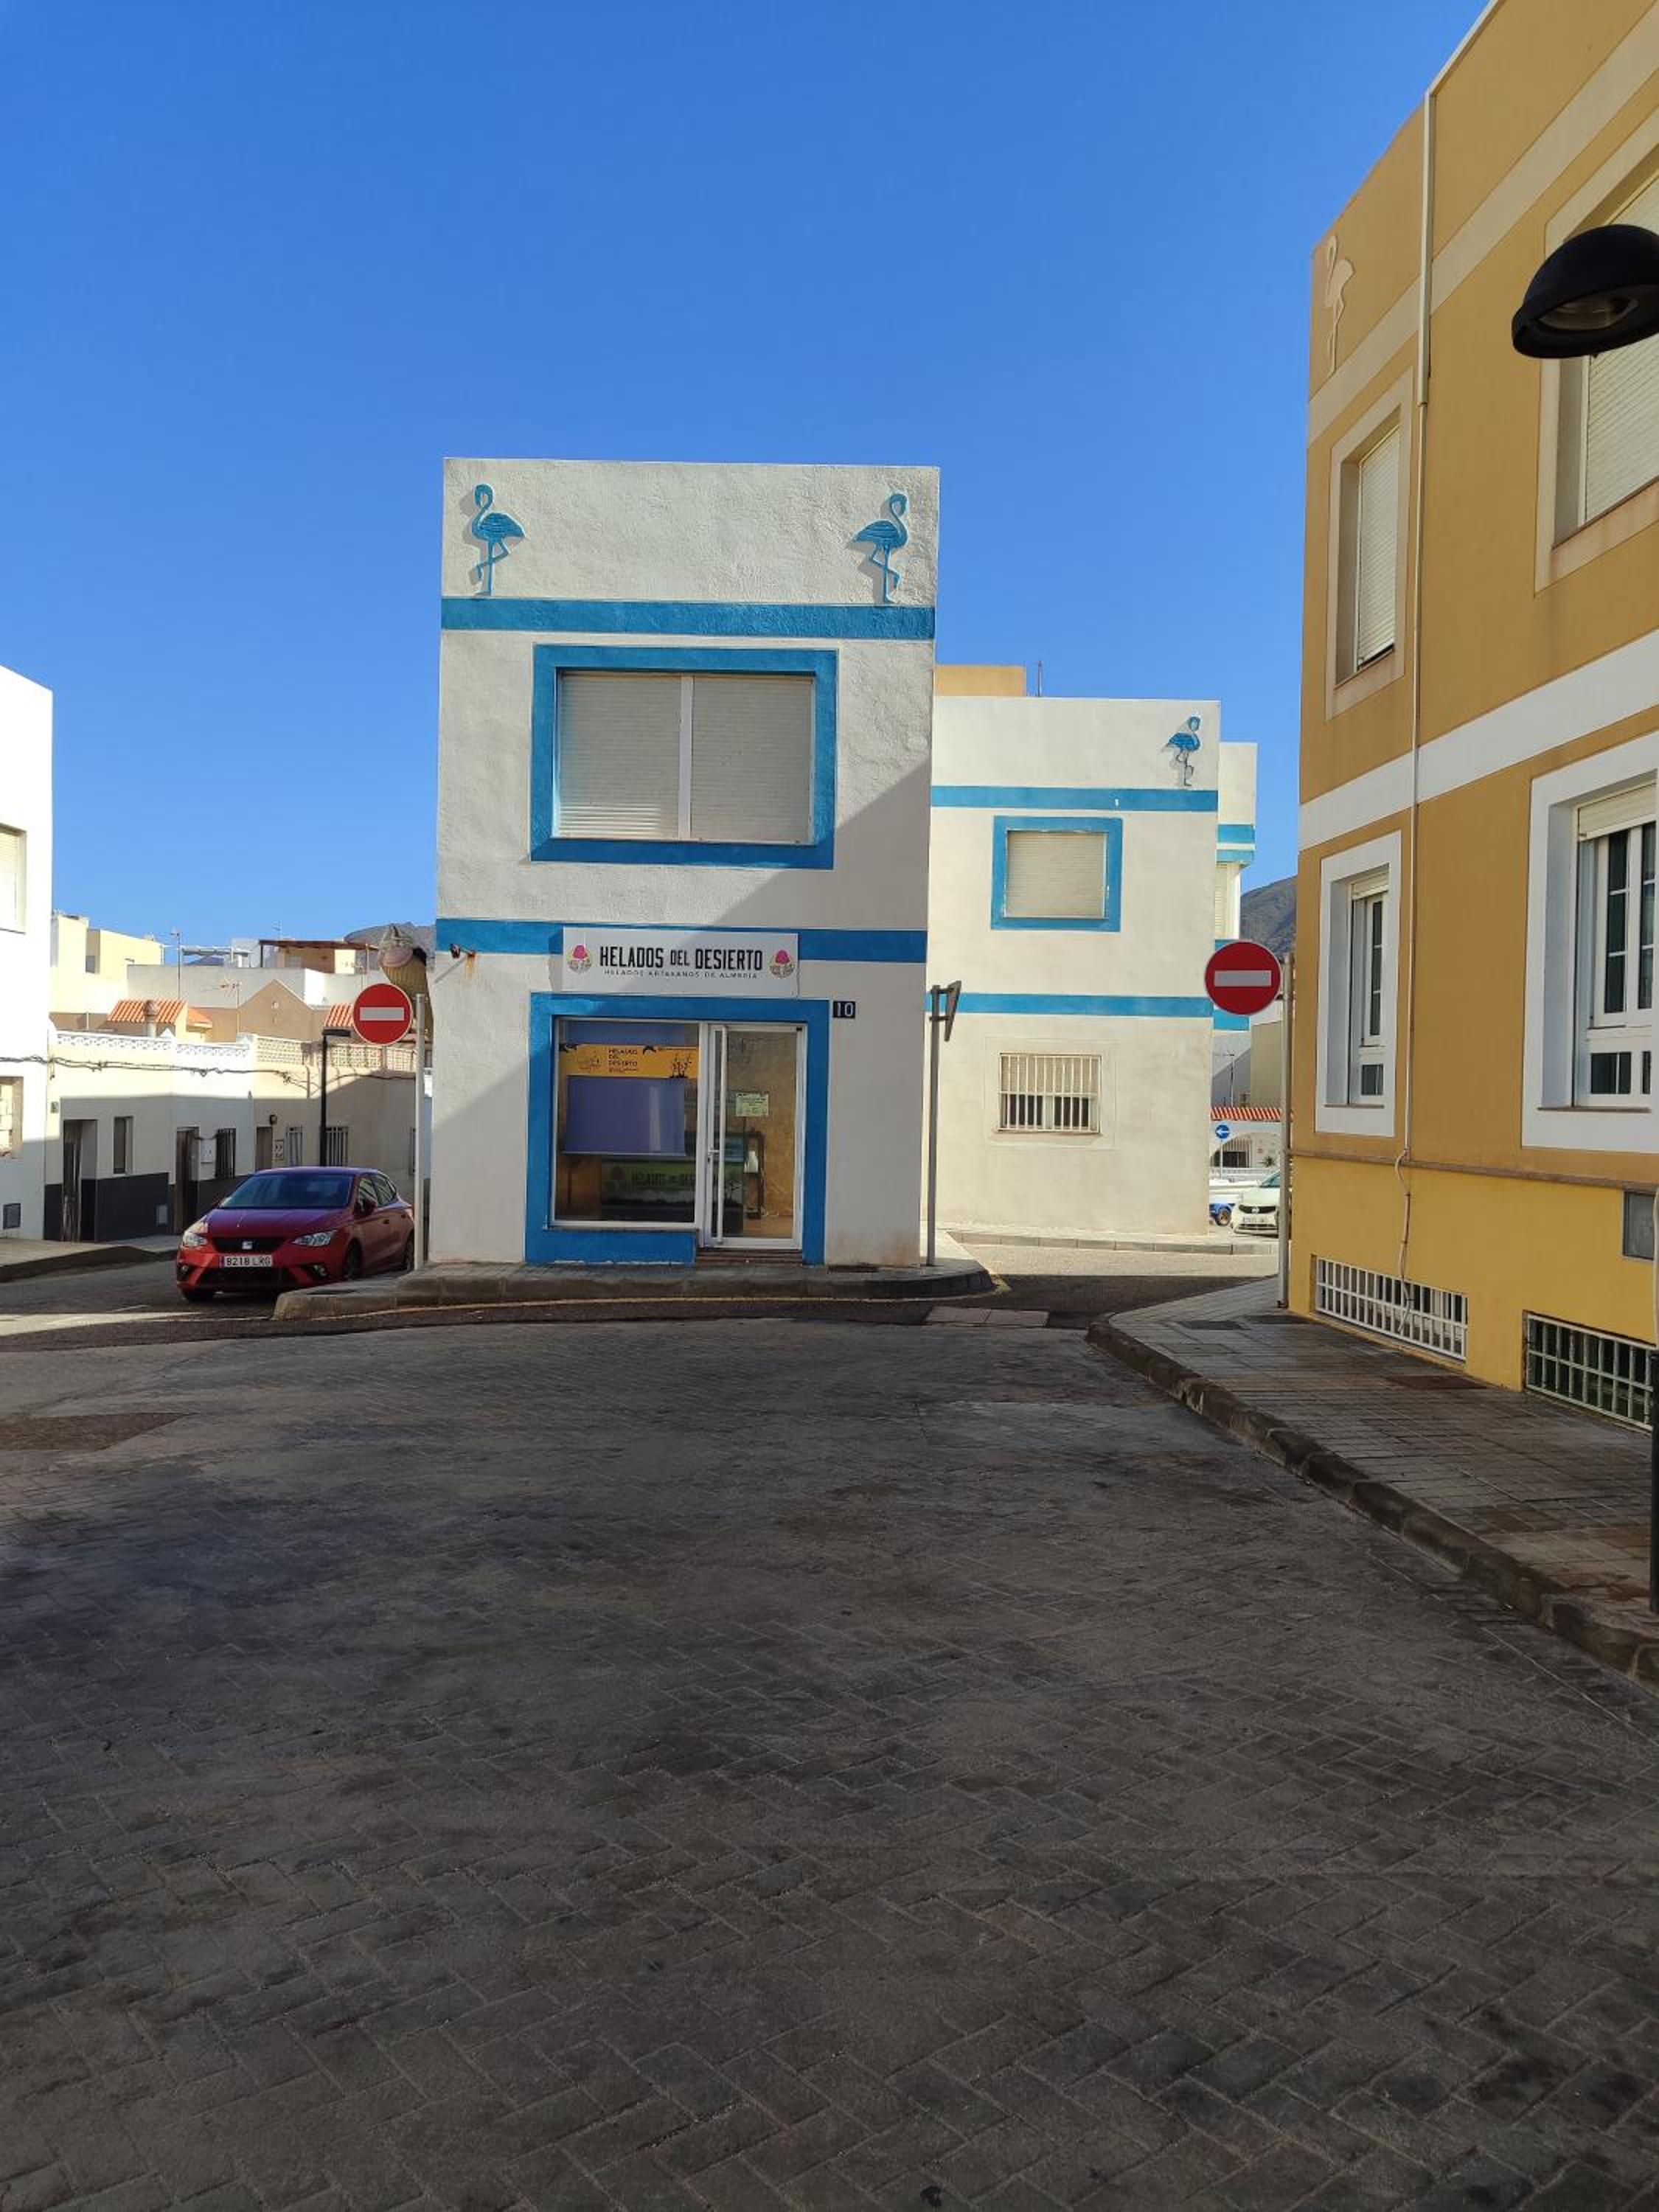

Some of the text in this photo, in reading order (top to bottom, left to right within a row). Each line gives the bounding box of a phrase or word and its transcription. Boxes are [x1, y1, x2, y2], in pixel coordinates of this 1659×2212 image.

[599, 946, 664, 968] HELADOS
[670, 949, 690, 966] DEL
[695, 948, 763, 970] DESIERTO
[837, 1002, 853, 1017] 10
[226, 1257, 250, 1266] 8218
